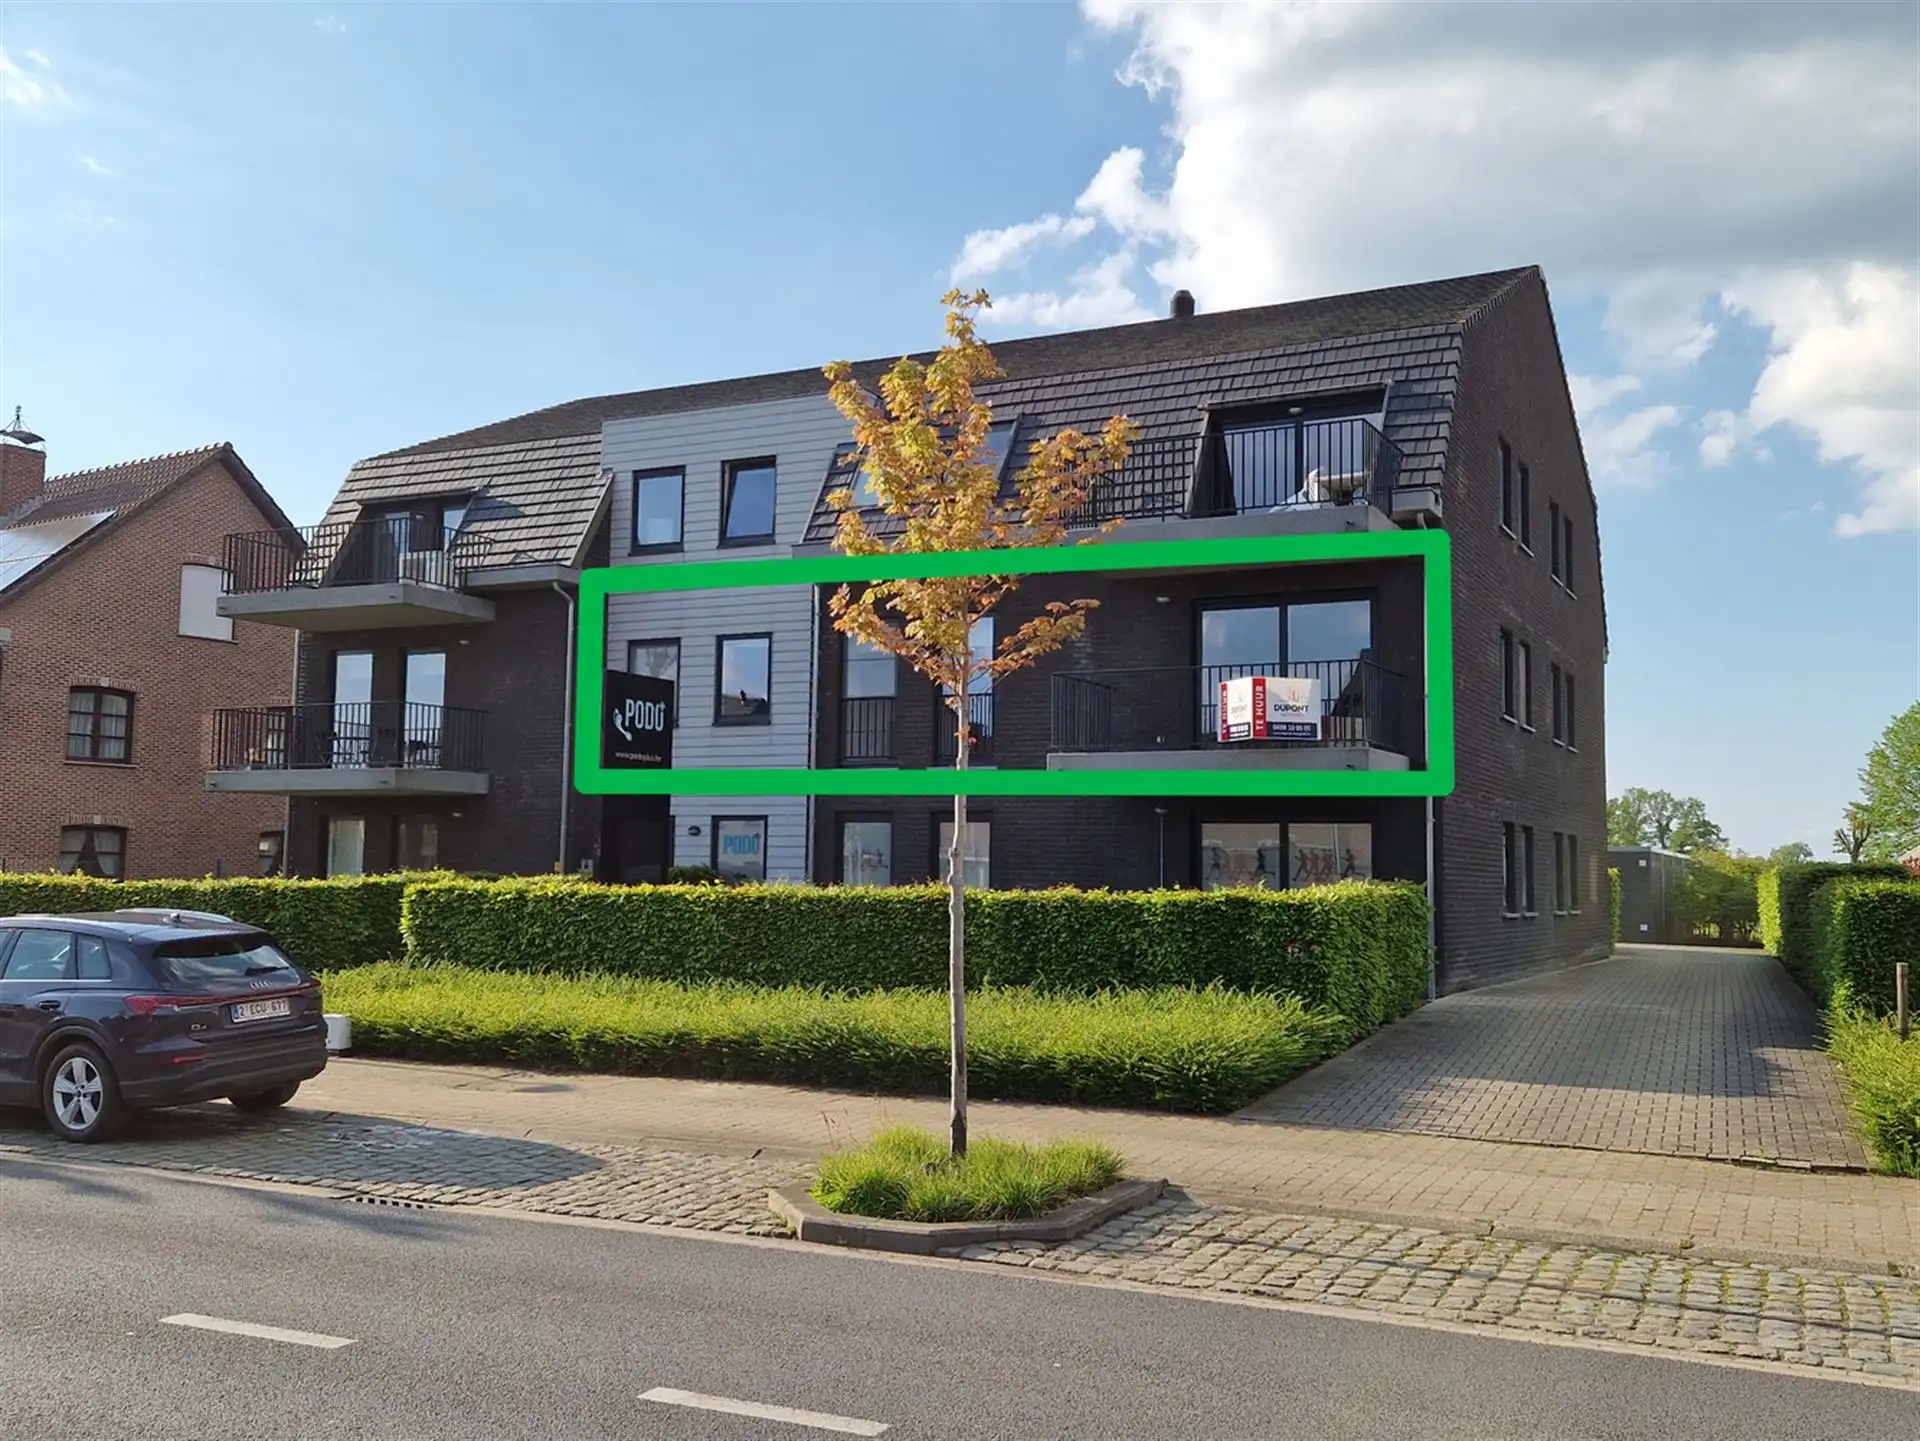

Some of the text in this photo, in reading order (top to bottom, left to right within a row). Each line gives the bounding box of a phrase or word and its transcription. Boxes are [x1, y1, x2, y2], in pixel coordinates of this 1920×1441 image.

[1255, 686, 1264, 730] TE HUUR
[1274, 704, 1309, 712] DUPONT
